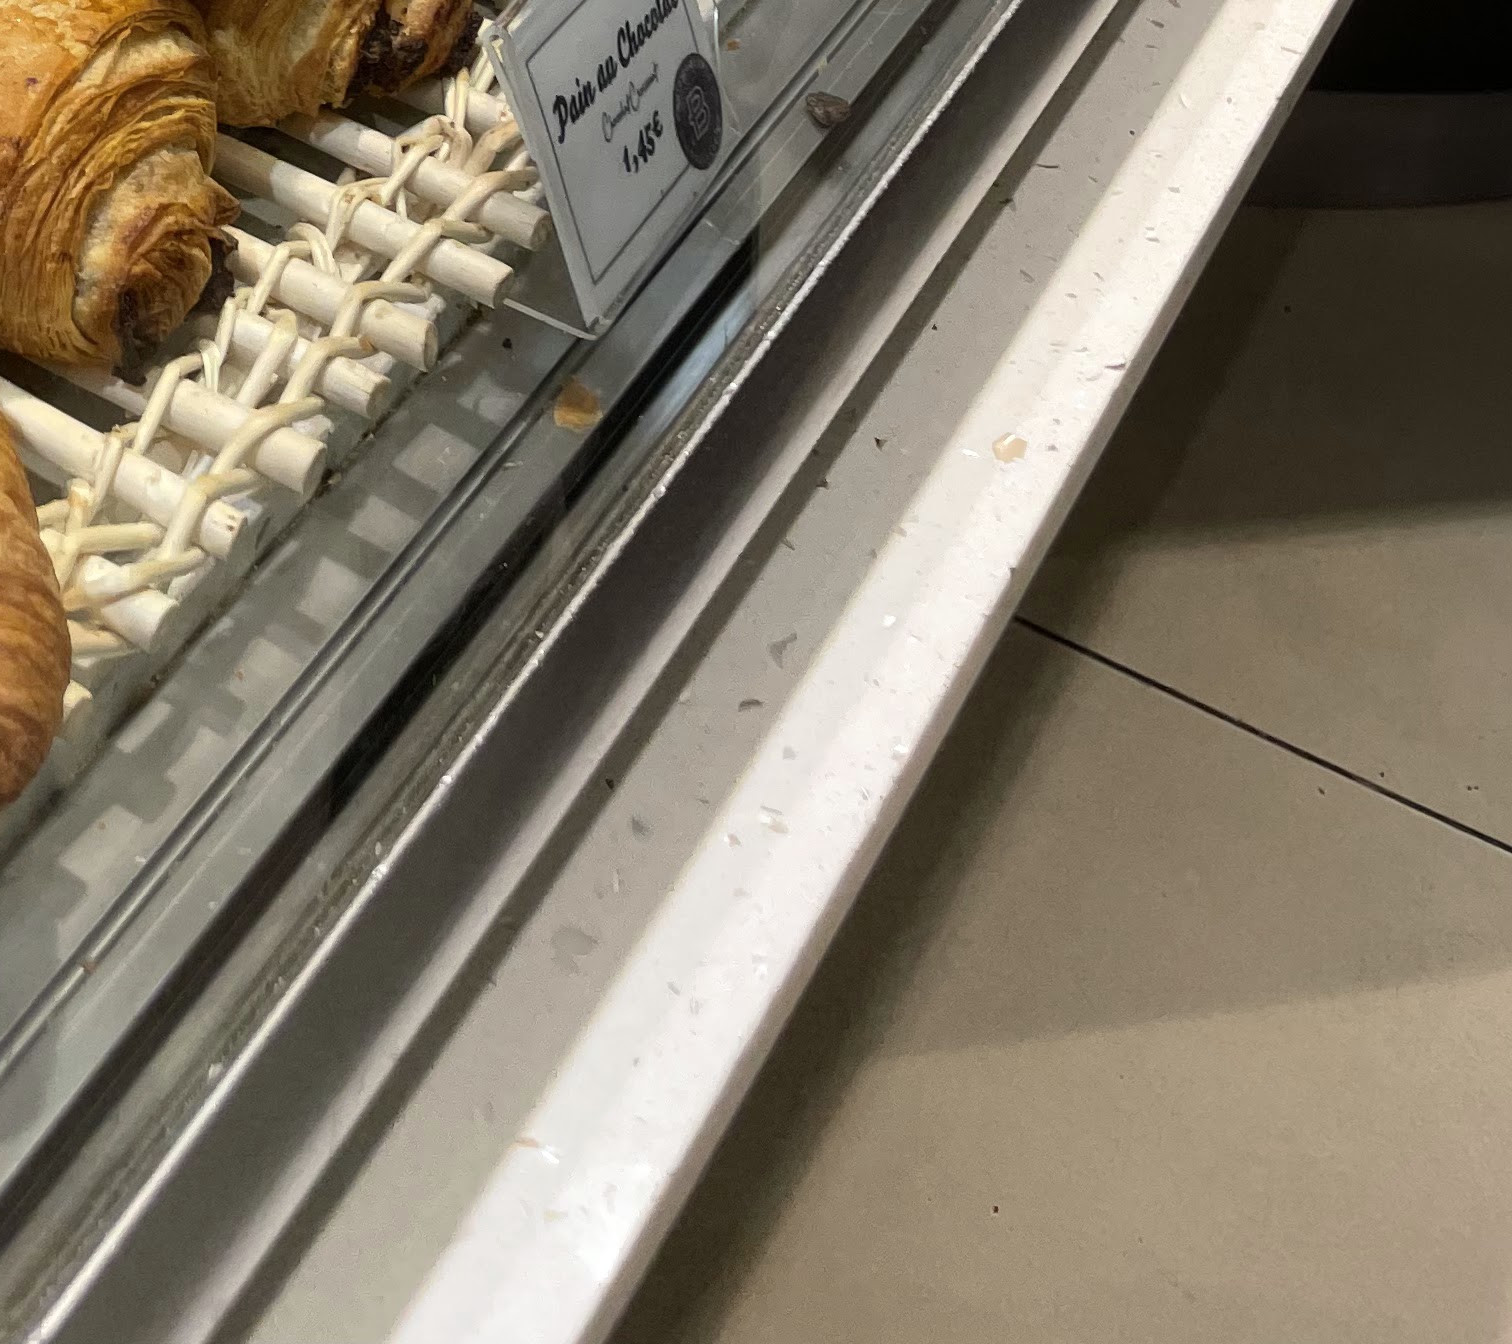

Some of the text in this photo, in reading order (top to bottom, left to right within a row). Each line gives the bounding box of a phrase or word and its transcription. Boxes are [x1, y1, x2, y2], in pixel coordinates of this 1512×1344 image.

[552, 76, 597, 145] Pain
[596, 55, 618, 93] au
[622, 109, 664, 174] 1,45€
